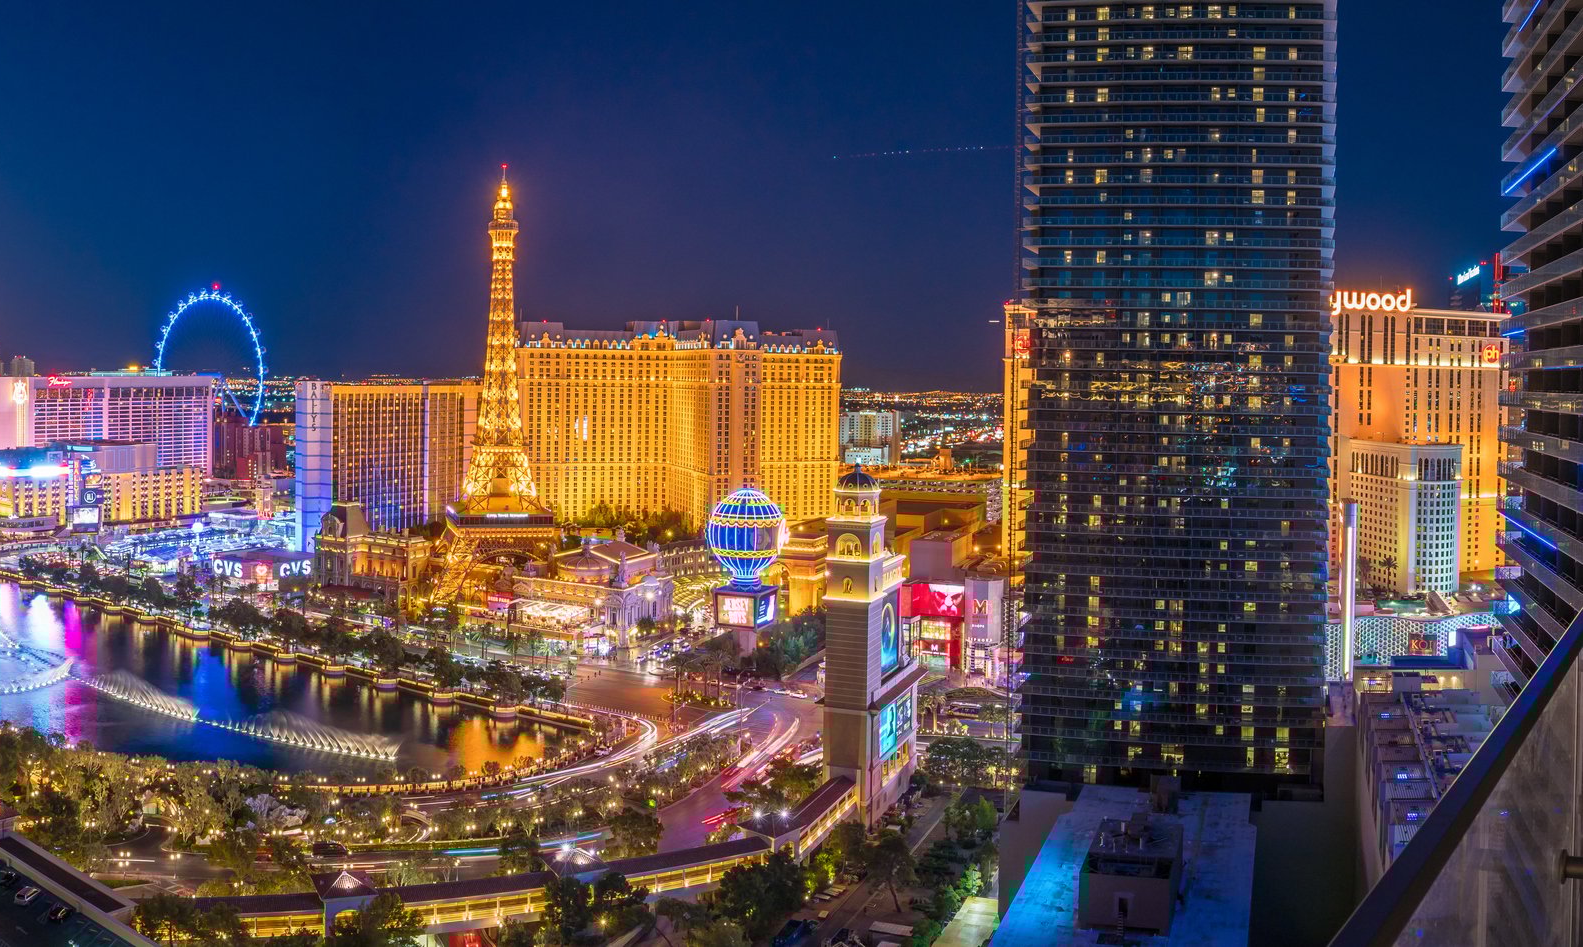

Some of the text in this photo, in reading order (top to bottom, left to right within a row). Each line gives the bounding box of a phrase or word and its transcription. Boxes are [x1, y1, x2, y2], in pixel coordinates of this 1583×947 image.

[1329, 288, 1412, 316] ywood
[213, 559, 243, 578] CVS
[279, 560, 312, 577] CVS
[722, 597, 749, 612] JERSEY
[728, 611, 747, 624] BOYS
[1411, 639, 1433, 650] KOI
